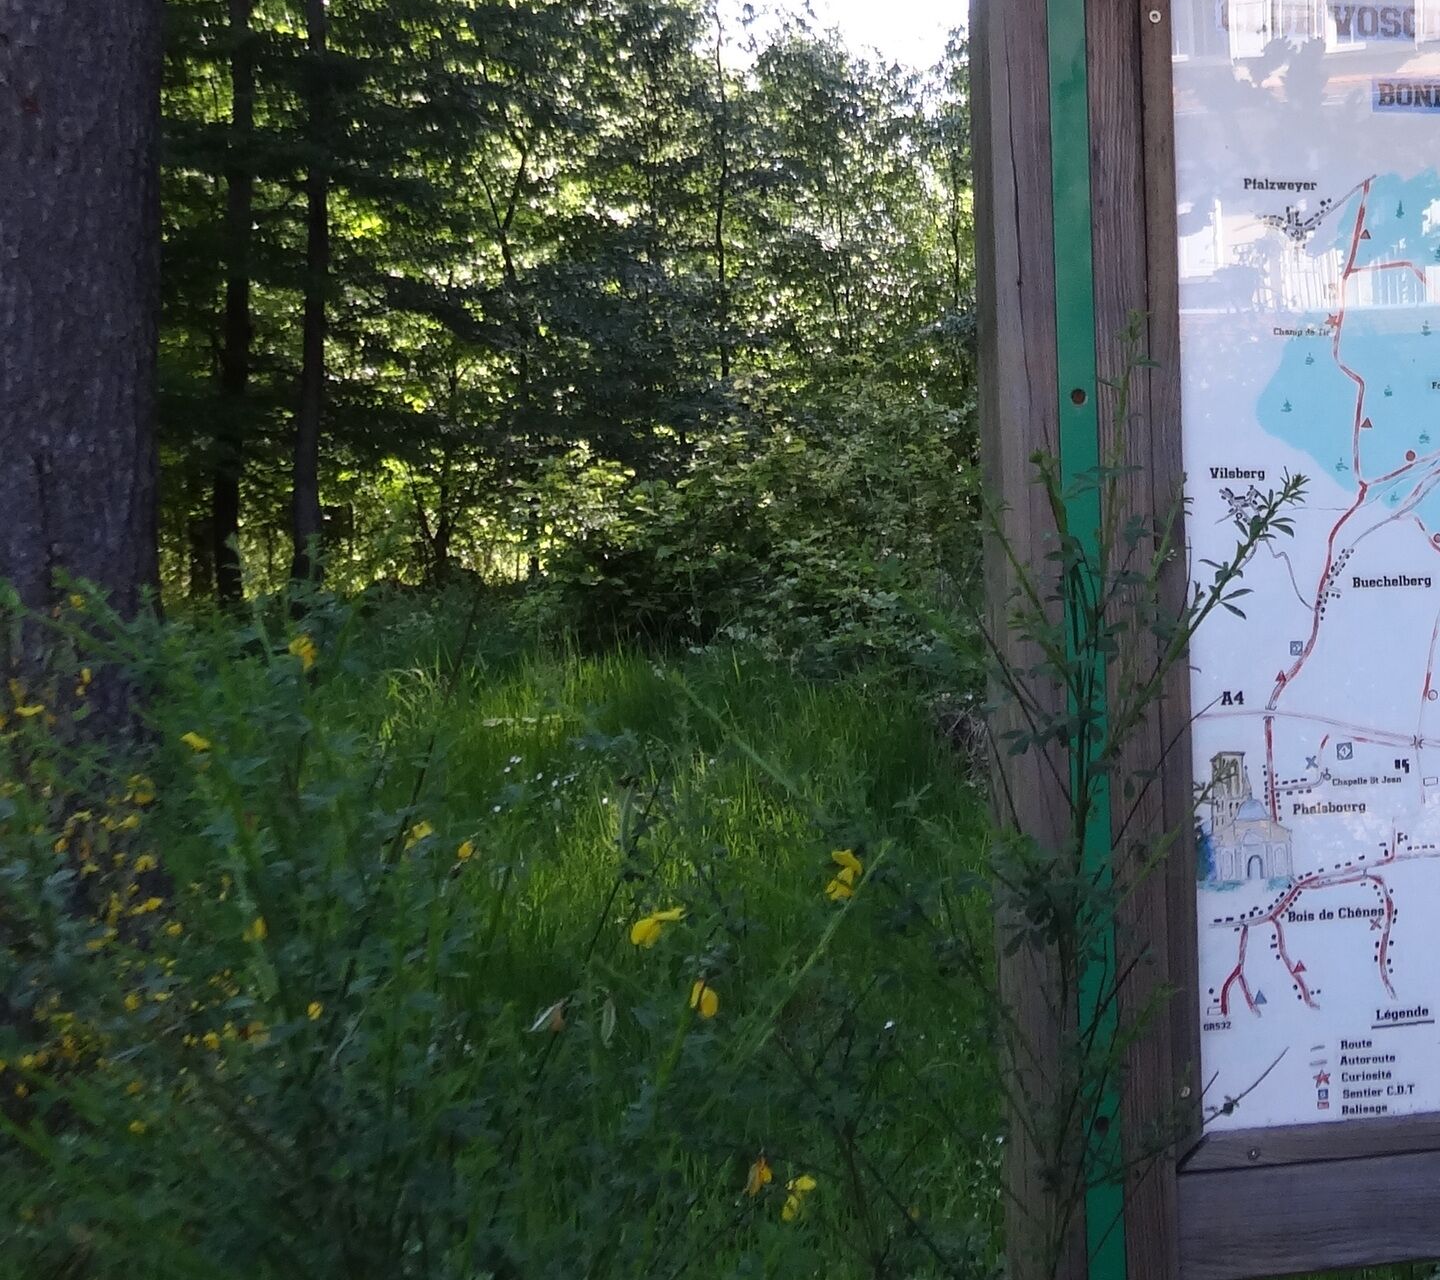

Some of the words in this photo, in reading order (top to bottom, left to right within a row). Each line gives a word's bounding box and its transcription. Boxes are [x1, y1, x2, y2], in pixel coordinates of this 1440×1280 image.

[1243, 178, 1317, 192] Pfalzweyer
[1209, 467, 1265, 481] Vilsberg
[1352, 575, 1432, 589] Buechelberg
[1220, 690, 1244, 706] A4
[1332, 776, 1367, 787] Chapelle
[1293, 801, 1366, 816] Phalsbourg
[1288, 910, 1315, 923] Bois
[1319, 908, 1334, 921] de
[1338, 906, 1385, 920] Chênes
[1376, 1005, 1429, 1021] Légende
[1340, 1039, 1373, 1051] Route
[1340, 1053, 1396, 1066] Autoroute
[1341, 1069, 1392, 1083] Curiosité
[1342, 1087, 1383, 1100] Sentier
[1341, 1104, 1388, 1116] Balisage
